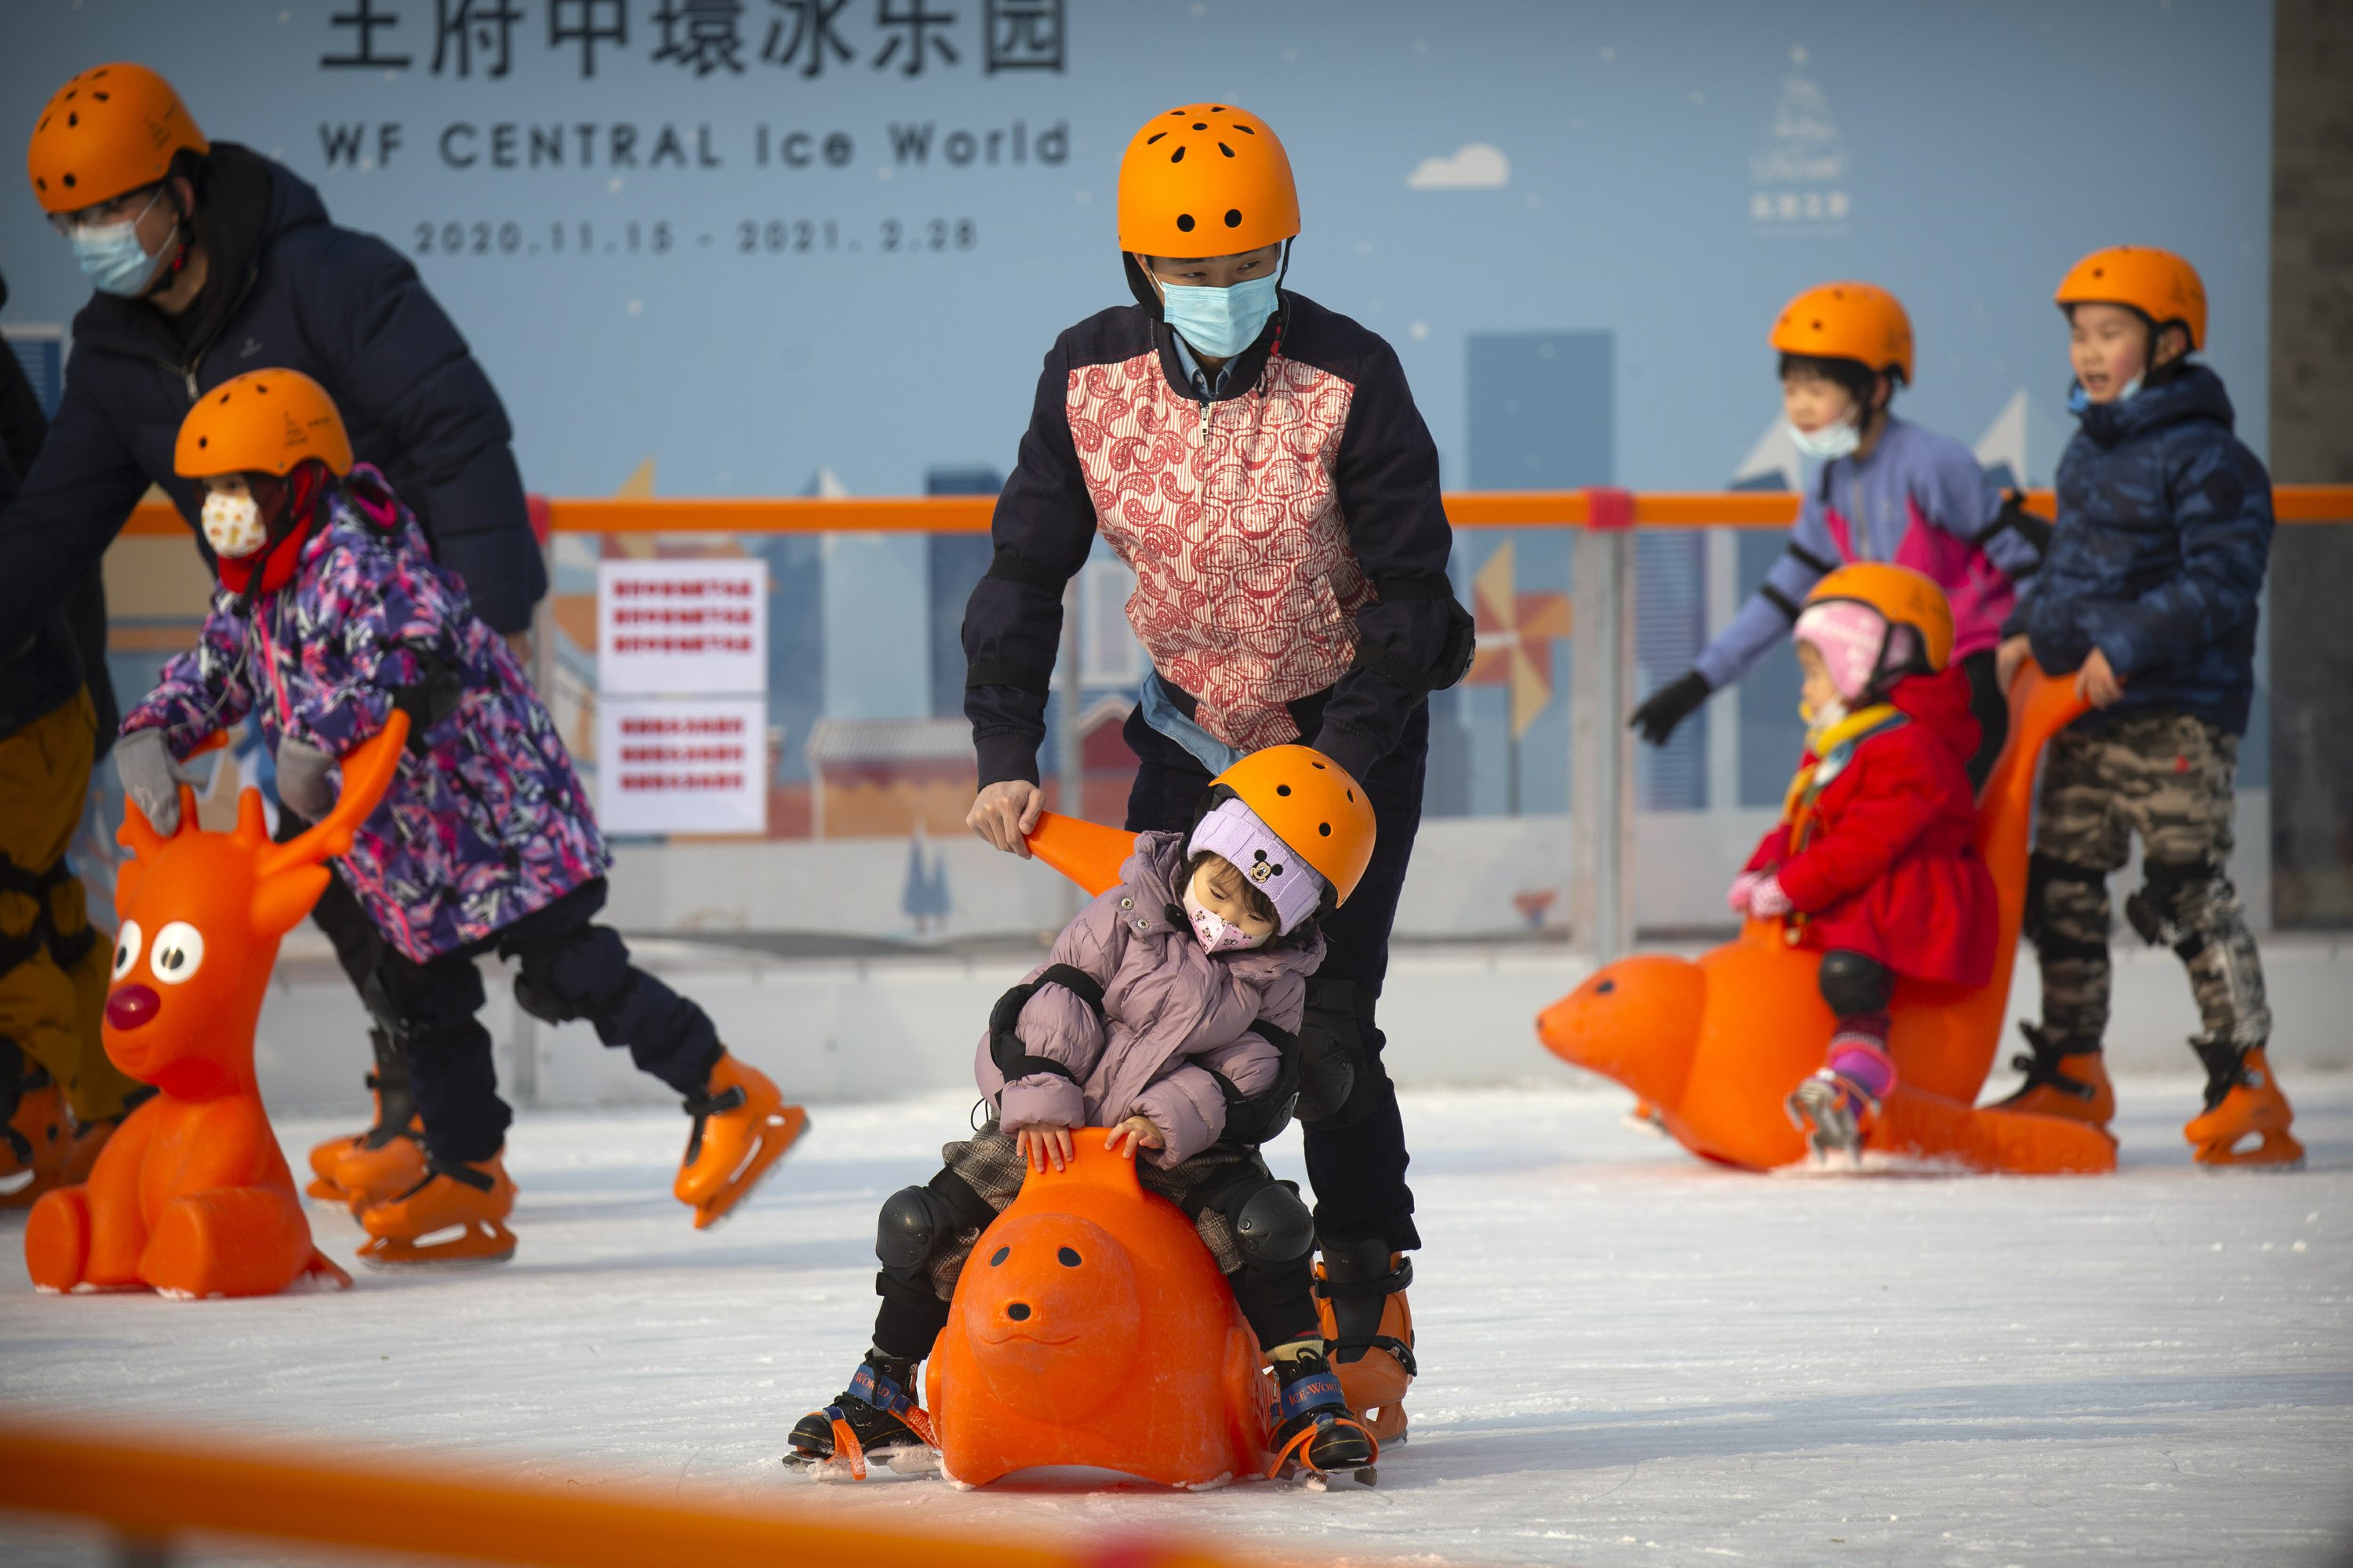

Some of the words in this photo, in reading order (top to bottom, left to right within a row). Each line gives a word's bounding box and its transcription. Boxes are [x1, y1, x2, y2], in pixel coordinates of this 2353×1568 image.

[318, 122, 402, 167] WF
[438, 122, 722, 169] CENTRAL
[755, 121, 856, 169] Ice
[888, 119, 1068, 168] World
[413, 220, 674, 256] 2020.11.15
